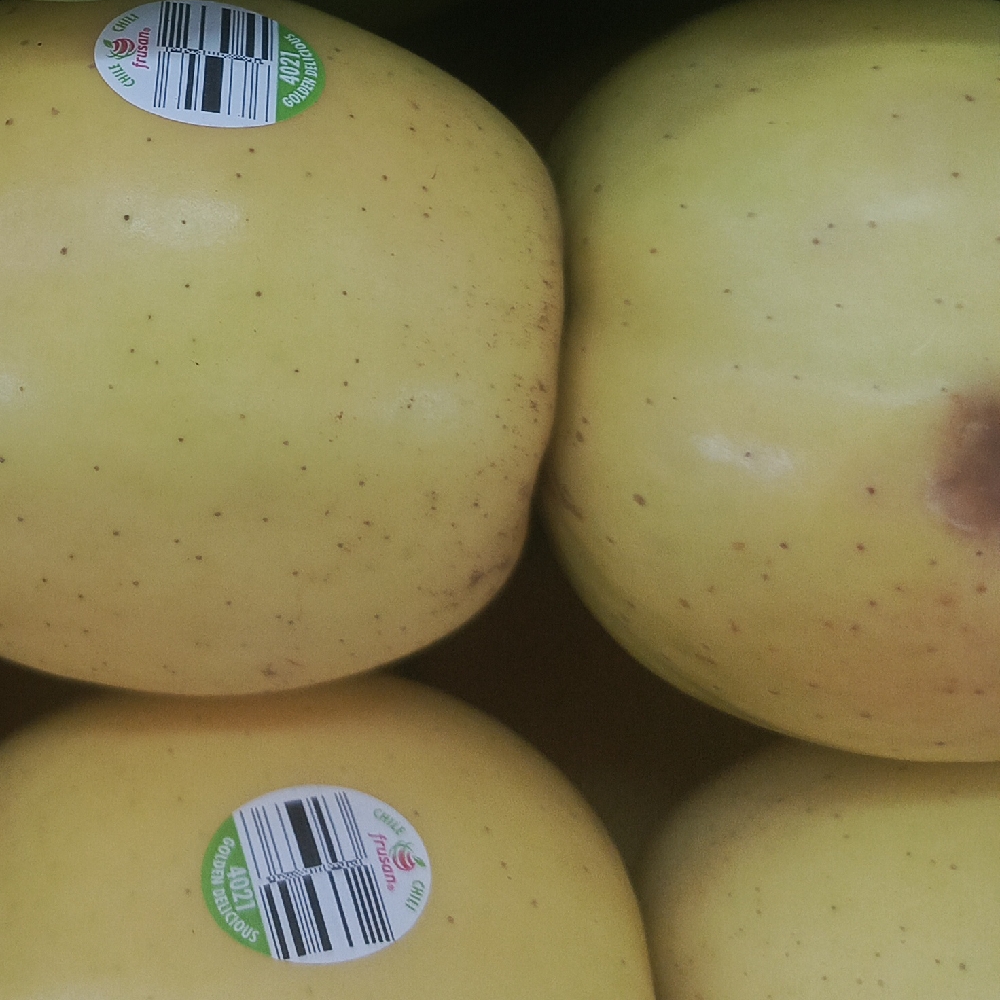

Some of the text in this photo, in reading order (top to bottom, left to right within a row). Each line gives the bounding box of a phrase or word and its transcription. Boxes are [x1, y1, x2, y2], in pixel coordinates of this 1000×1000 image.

[108, 63, 135, 87] CHILE
[279, 51, 300, 85] 4021
[282, 34, 317, 107] GOLDEN DELICIOUS
[373, 808, 406, 836] CHILE
[211, 837, 259, 943] GOLDEN DELICIOUS
[227, 866, 256, 911] 4021
